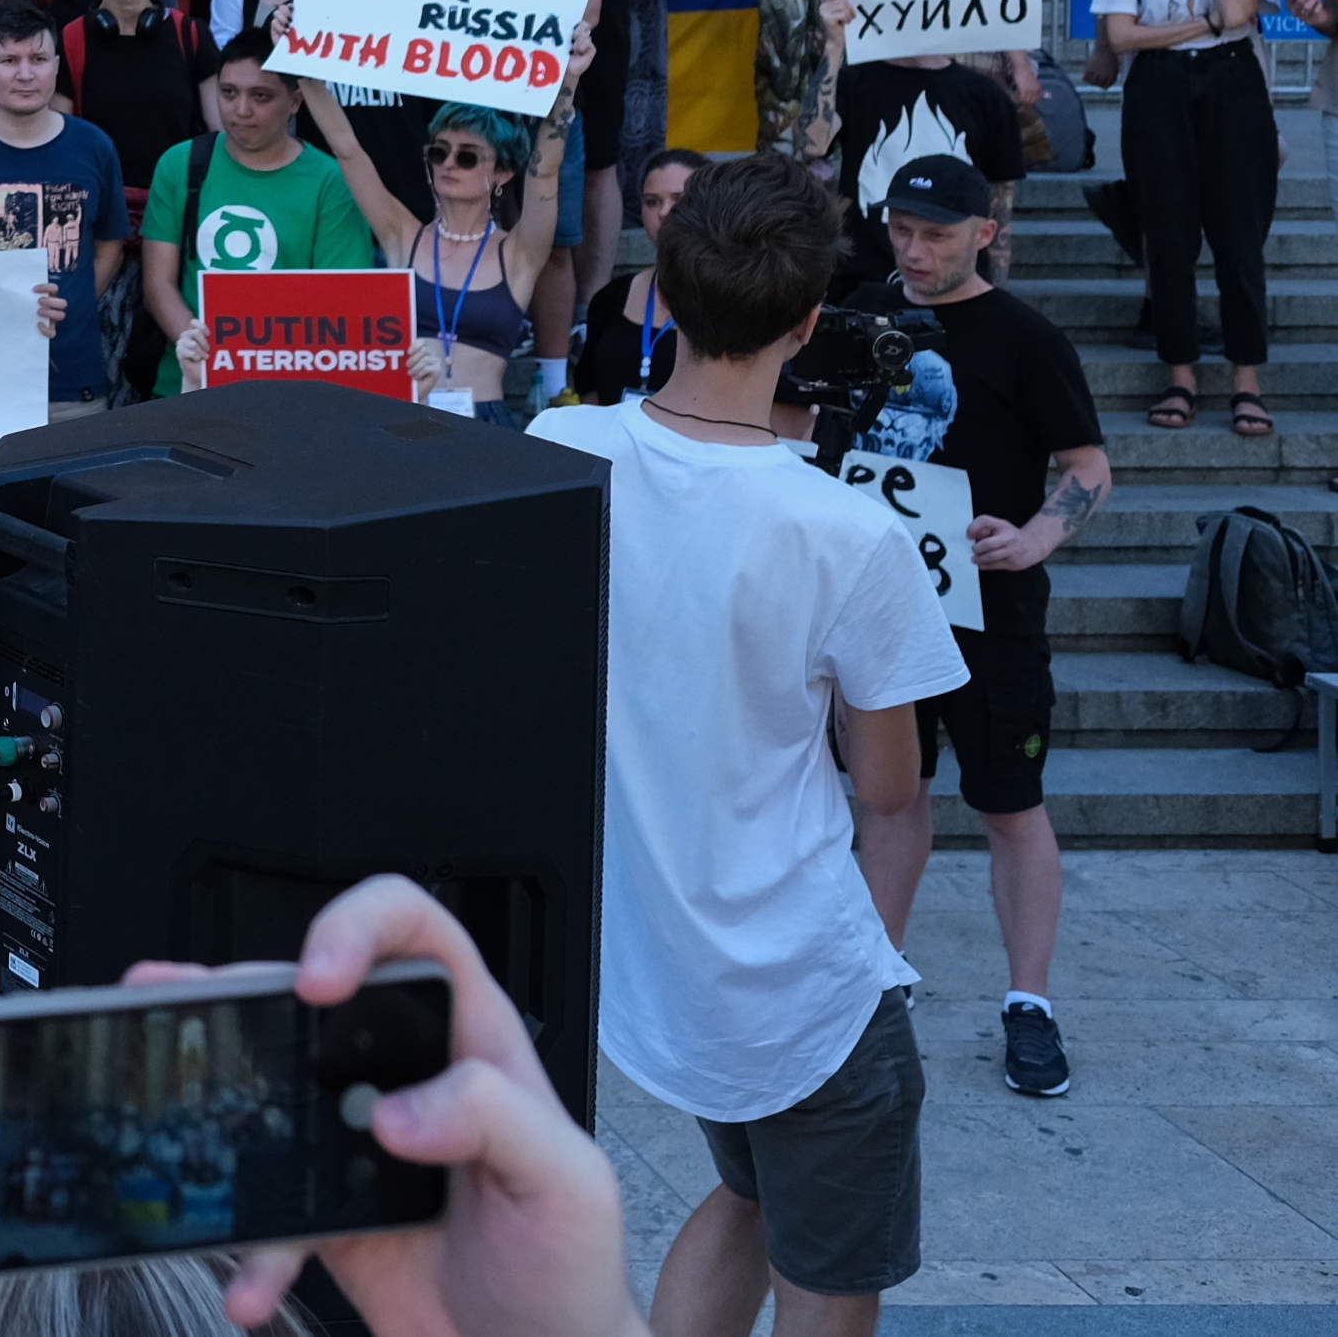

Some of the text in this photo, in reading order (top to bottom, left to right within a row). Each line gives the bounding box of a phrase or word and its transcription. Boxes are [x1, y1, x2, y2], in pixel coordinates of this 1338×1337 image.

[418, 3, 563, 47] RUSSIA
[287, 27, 561, 88] WITH BLOOD
[214, 316, 404, 346] PUTIN IS
[213, 349, 405, 371] A TERRORIST
[17, 824, 50, 849] Electro-Voice
[17, 841, 37, 862] ZLX
